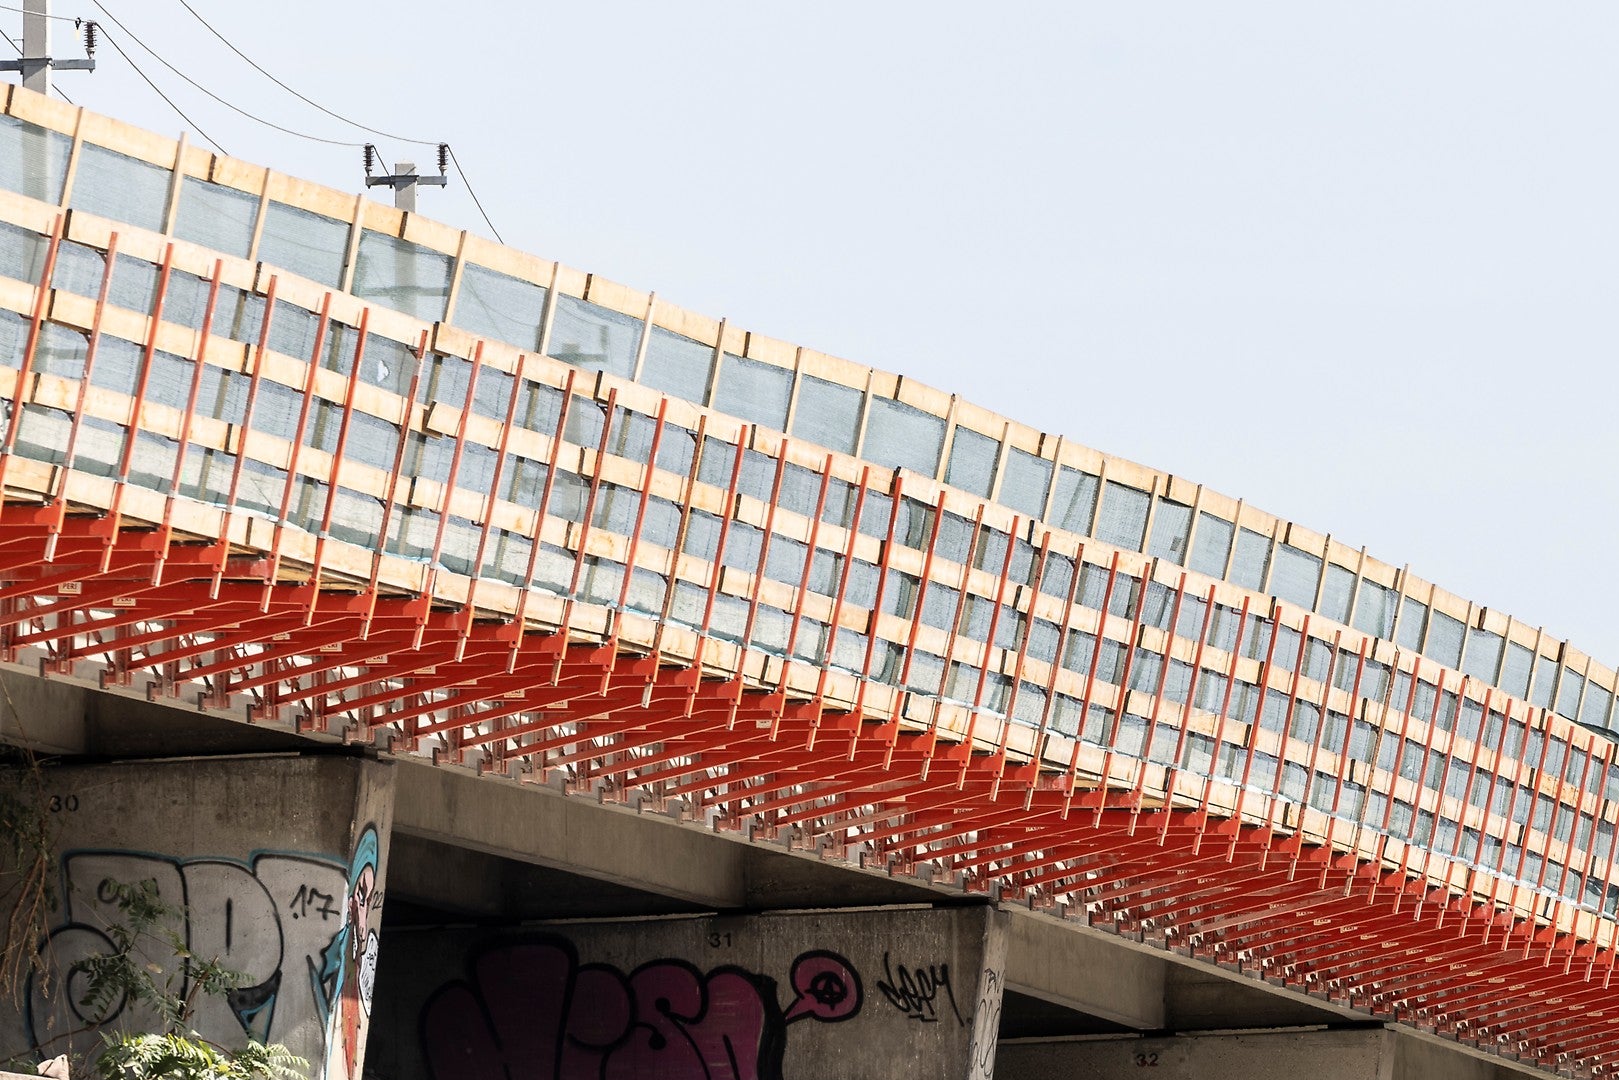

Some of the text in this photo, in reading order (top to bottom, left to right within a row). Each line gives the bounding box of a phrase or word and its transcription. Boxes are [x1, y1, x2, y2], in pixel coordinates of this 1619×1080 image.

[49, 794, 79, 813] 30
[709, 932, 732, 948] 31
[1136, 1052, 1159, 1067] 32
